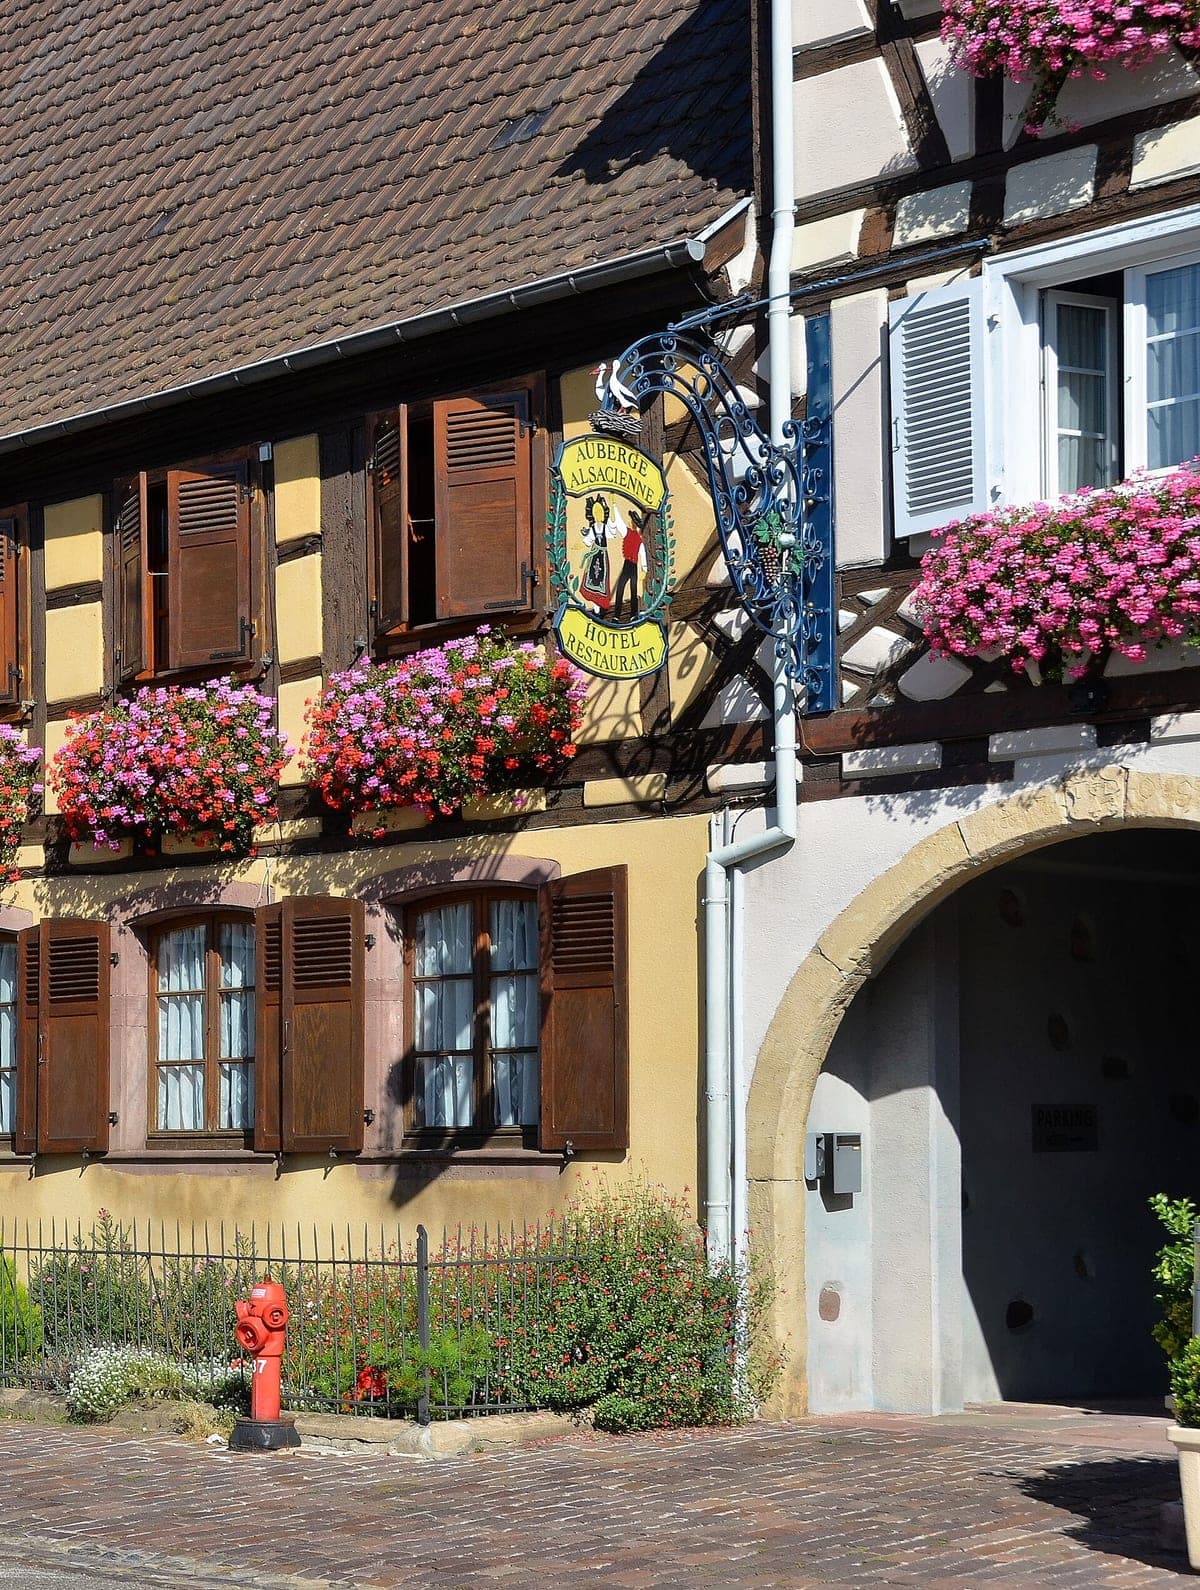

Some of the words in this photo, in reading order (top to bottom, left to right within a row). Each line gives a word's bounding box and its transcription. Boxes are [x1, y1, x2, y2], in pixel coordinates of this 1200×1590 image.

[576, 442, 648, 477] AUBERGE
[570, 466, 655, 504] ALSACIENNE
[565, 632, 655, 671] RESTAURANT
[584, 622, 640, 649] HOTEL
[1038, 1109, 1096, 1127] PARKING
